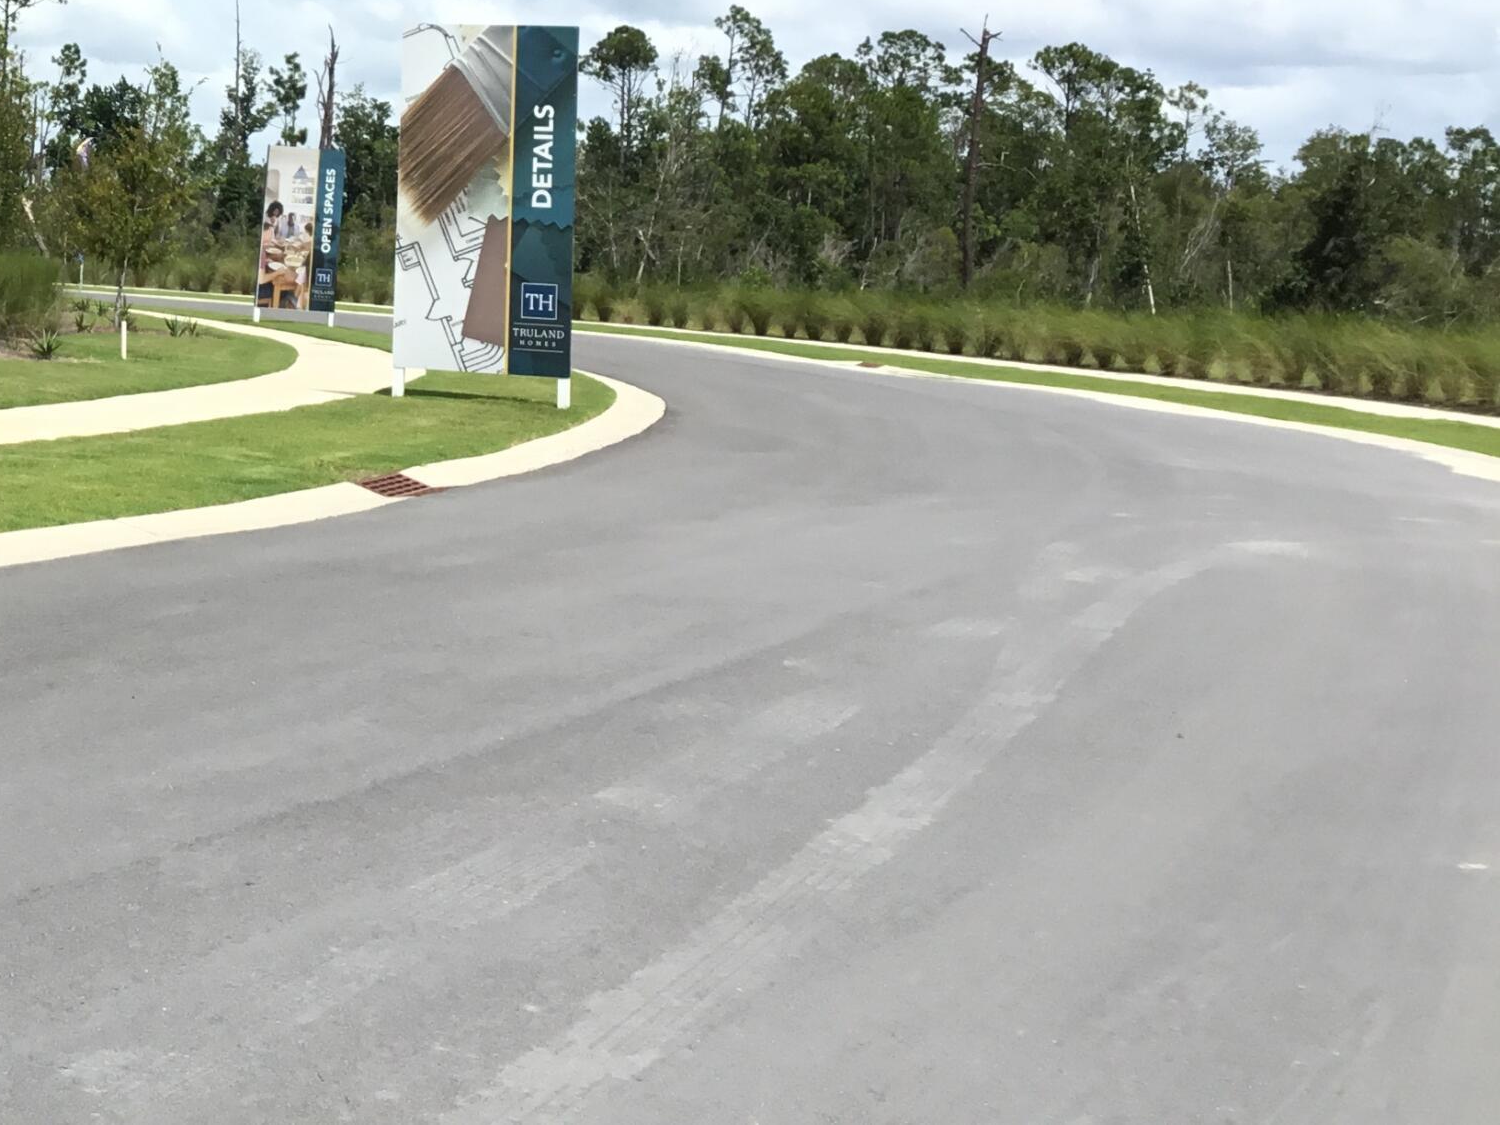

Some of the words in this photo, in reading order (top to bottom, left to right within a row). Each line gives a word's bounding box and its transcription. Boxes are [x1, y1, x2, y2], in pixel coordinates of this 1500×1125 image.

[531, 104, 555, 209] DETAILS
[323, 168, 337, 215] SPACES
[320, 217, 333, 254] OPEN
[317, 273, 331, 283] TH
[525, 292, 554, 312] TH
[512, 327, 565, 340] TRULAND
[519, 339, 557, 348] HOMES
